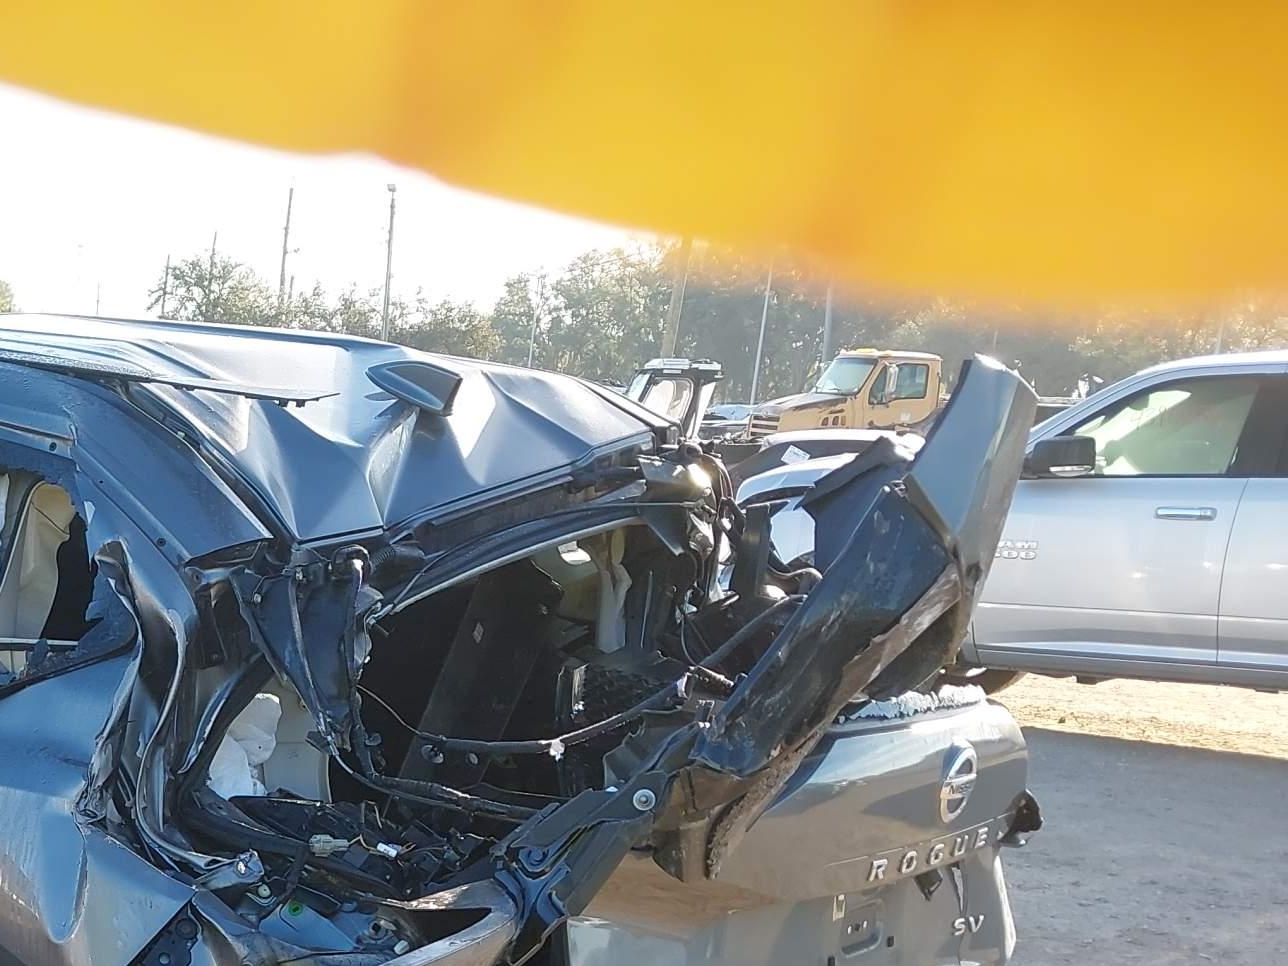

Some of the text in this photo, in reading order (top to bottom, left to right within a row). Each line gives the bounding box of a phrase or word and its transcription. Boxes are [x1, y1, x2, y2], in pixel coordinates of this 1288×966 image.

[998, 540, 1038, 549] AM
[868, 827, 988, 882] ROGUE
[953, 915, 984, 936] SV
